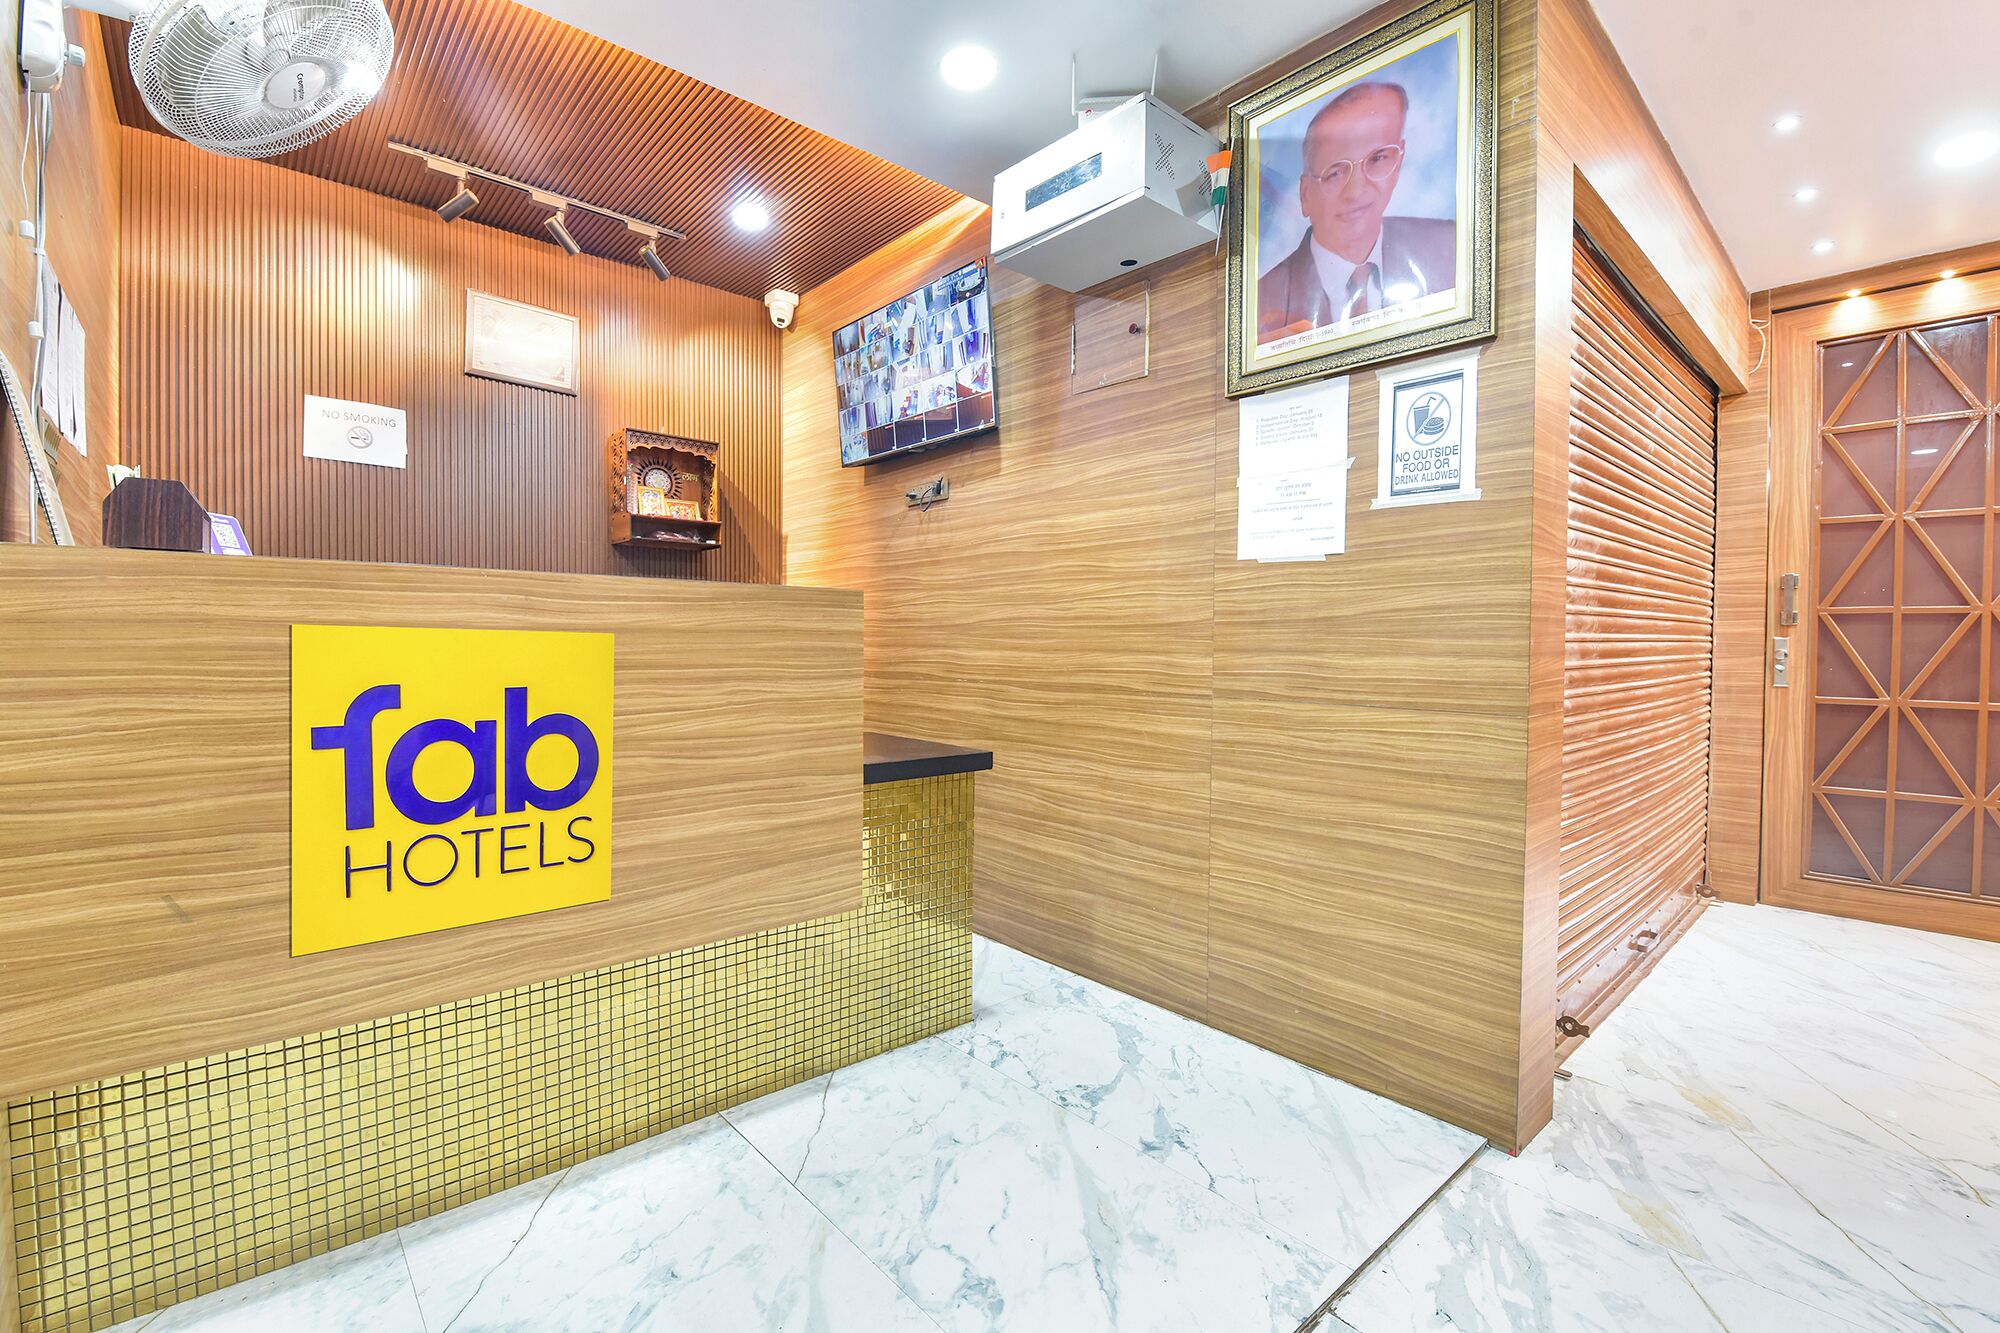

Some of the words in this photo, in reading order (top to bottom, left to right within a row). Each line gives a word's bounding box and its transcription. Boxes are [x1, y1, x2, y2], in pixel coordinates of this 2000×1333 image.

[322, 409, 340, 420] NO
[343, 411, 397, 428] SMOKING
[1396, 451, 1411, 463] NO
[1413, 444, 1459, 461] OUTSIDE
[1402, 460, 1432, 473] FOOD
[1434, 457, 1450, 470] OR
[1395, 473, 1419, 486] DRINK
[1421, 468, 1459, 482] ALLOWED
[311, 684, 599, 830] fab
[345, 816, 595, 898] HOTELS
